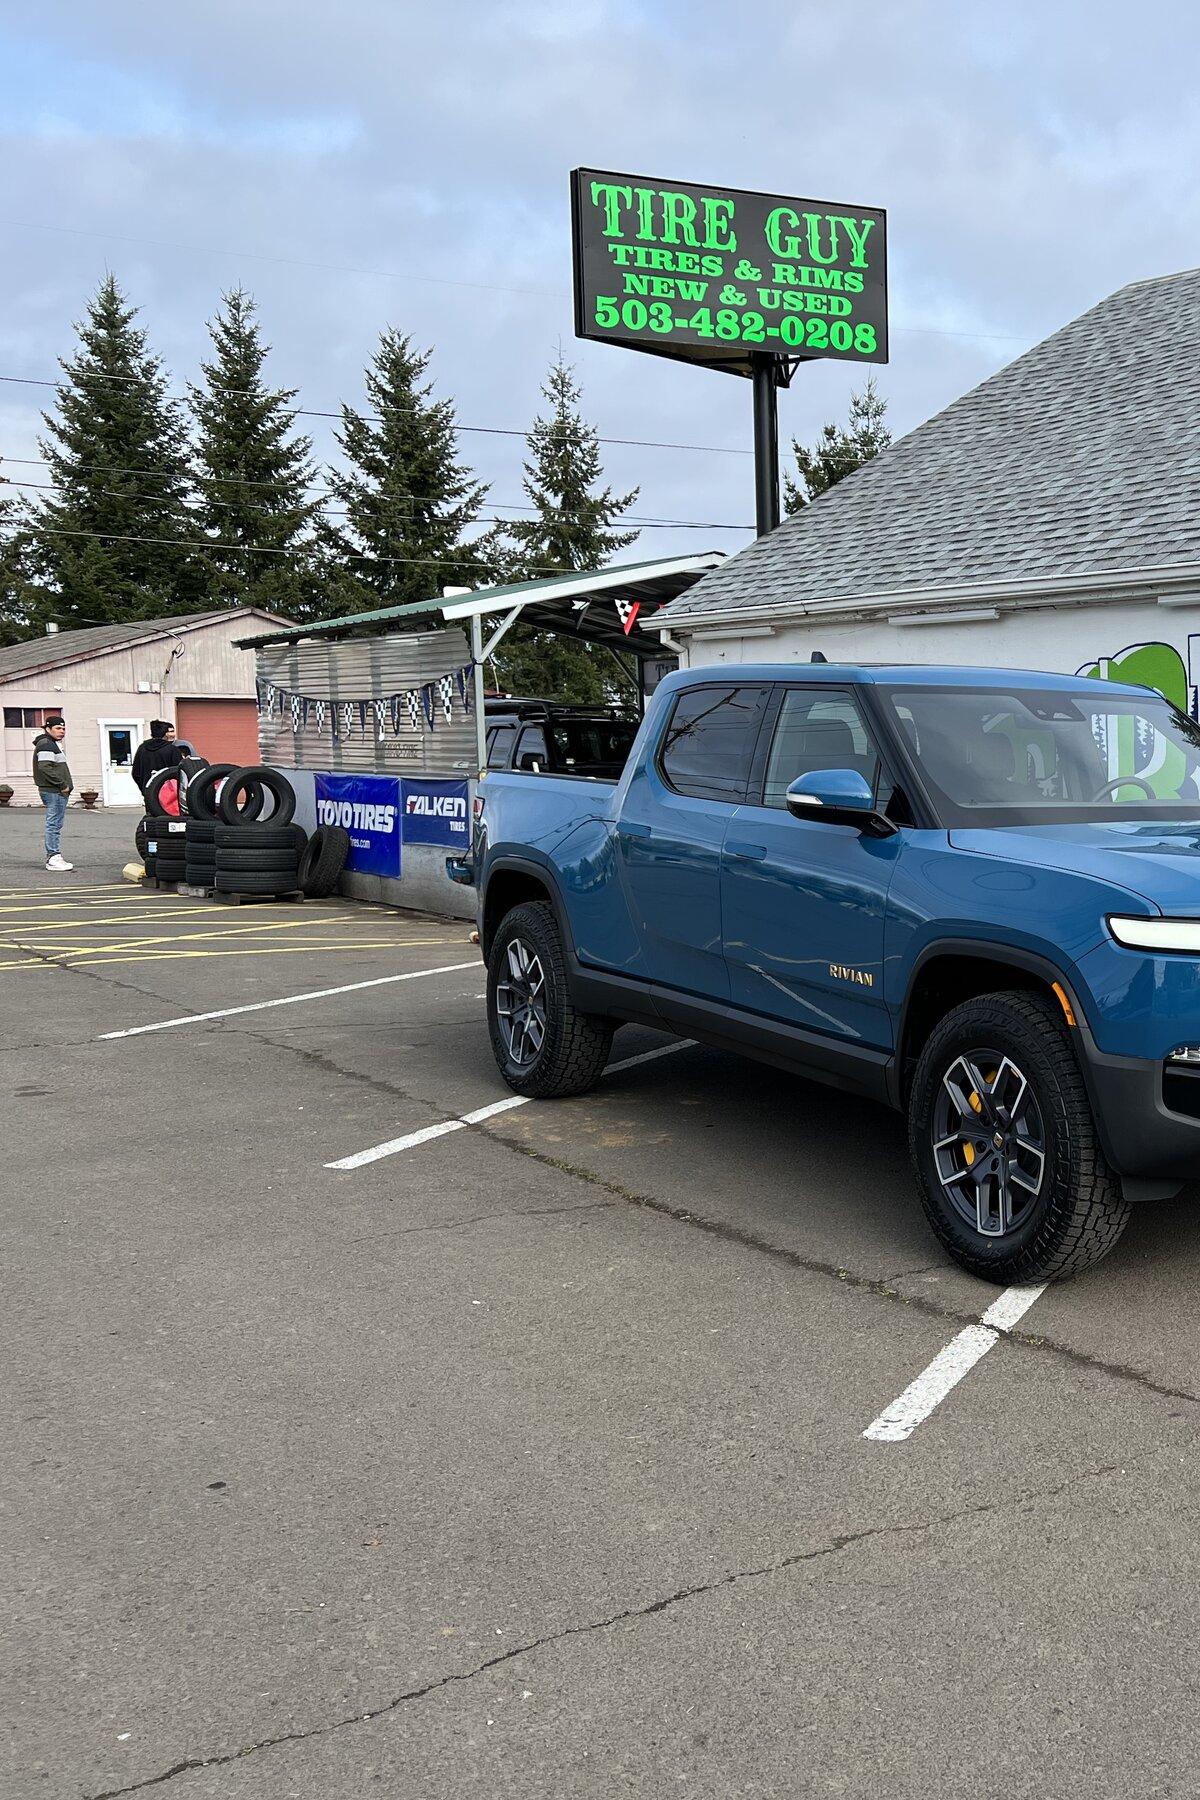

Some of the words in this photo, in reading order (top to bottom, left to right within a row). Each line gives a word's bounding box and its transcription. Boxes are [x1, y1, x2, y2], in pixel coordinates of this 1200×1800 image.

[590, 181, 738, 253] TIRE
[764, 207, 876, 269] GUY
[608, 243, 724, 277] TIRES
[733, 259, 763, 282] &
[772, 263, 865, 293] RIMS
[622, 273, 709, 302] NEW
[719, 284, 748, 306] &
[757, 287, 853, 316] USED
[594, 295, 878, 354] 503-482-0208
[406, 795, 466, 818] FALKEN
[829, 964, 873, 987] RIVIAN
